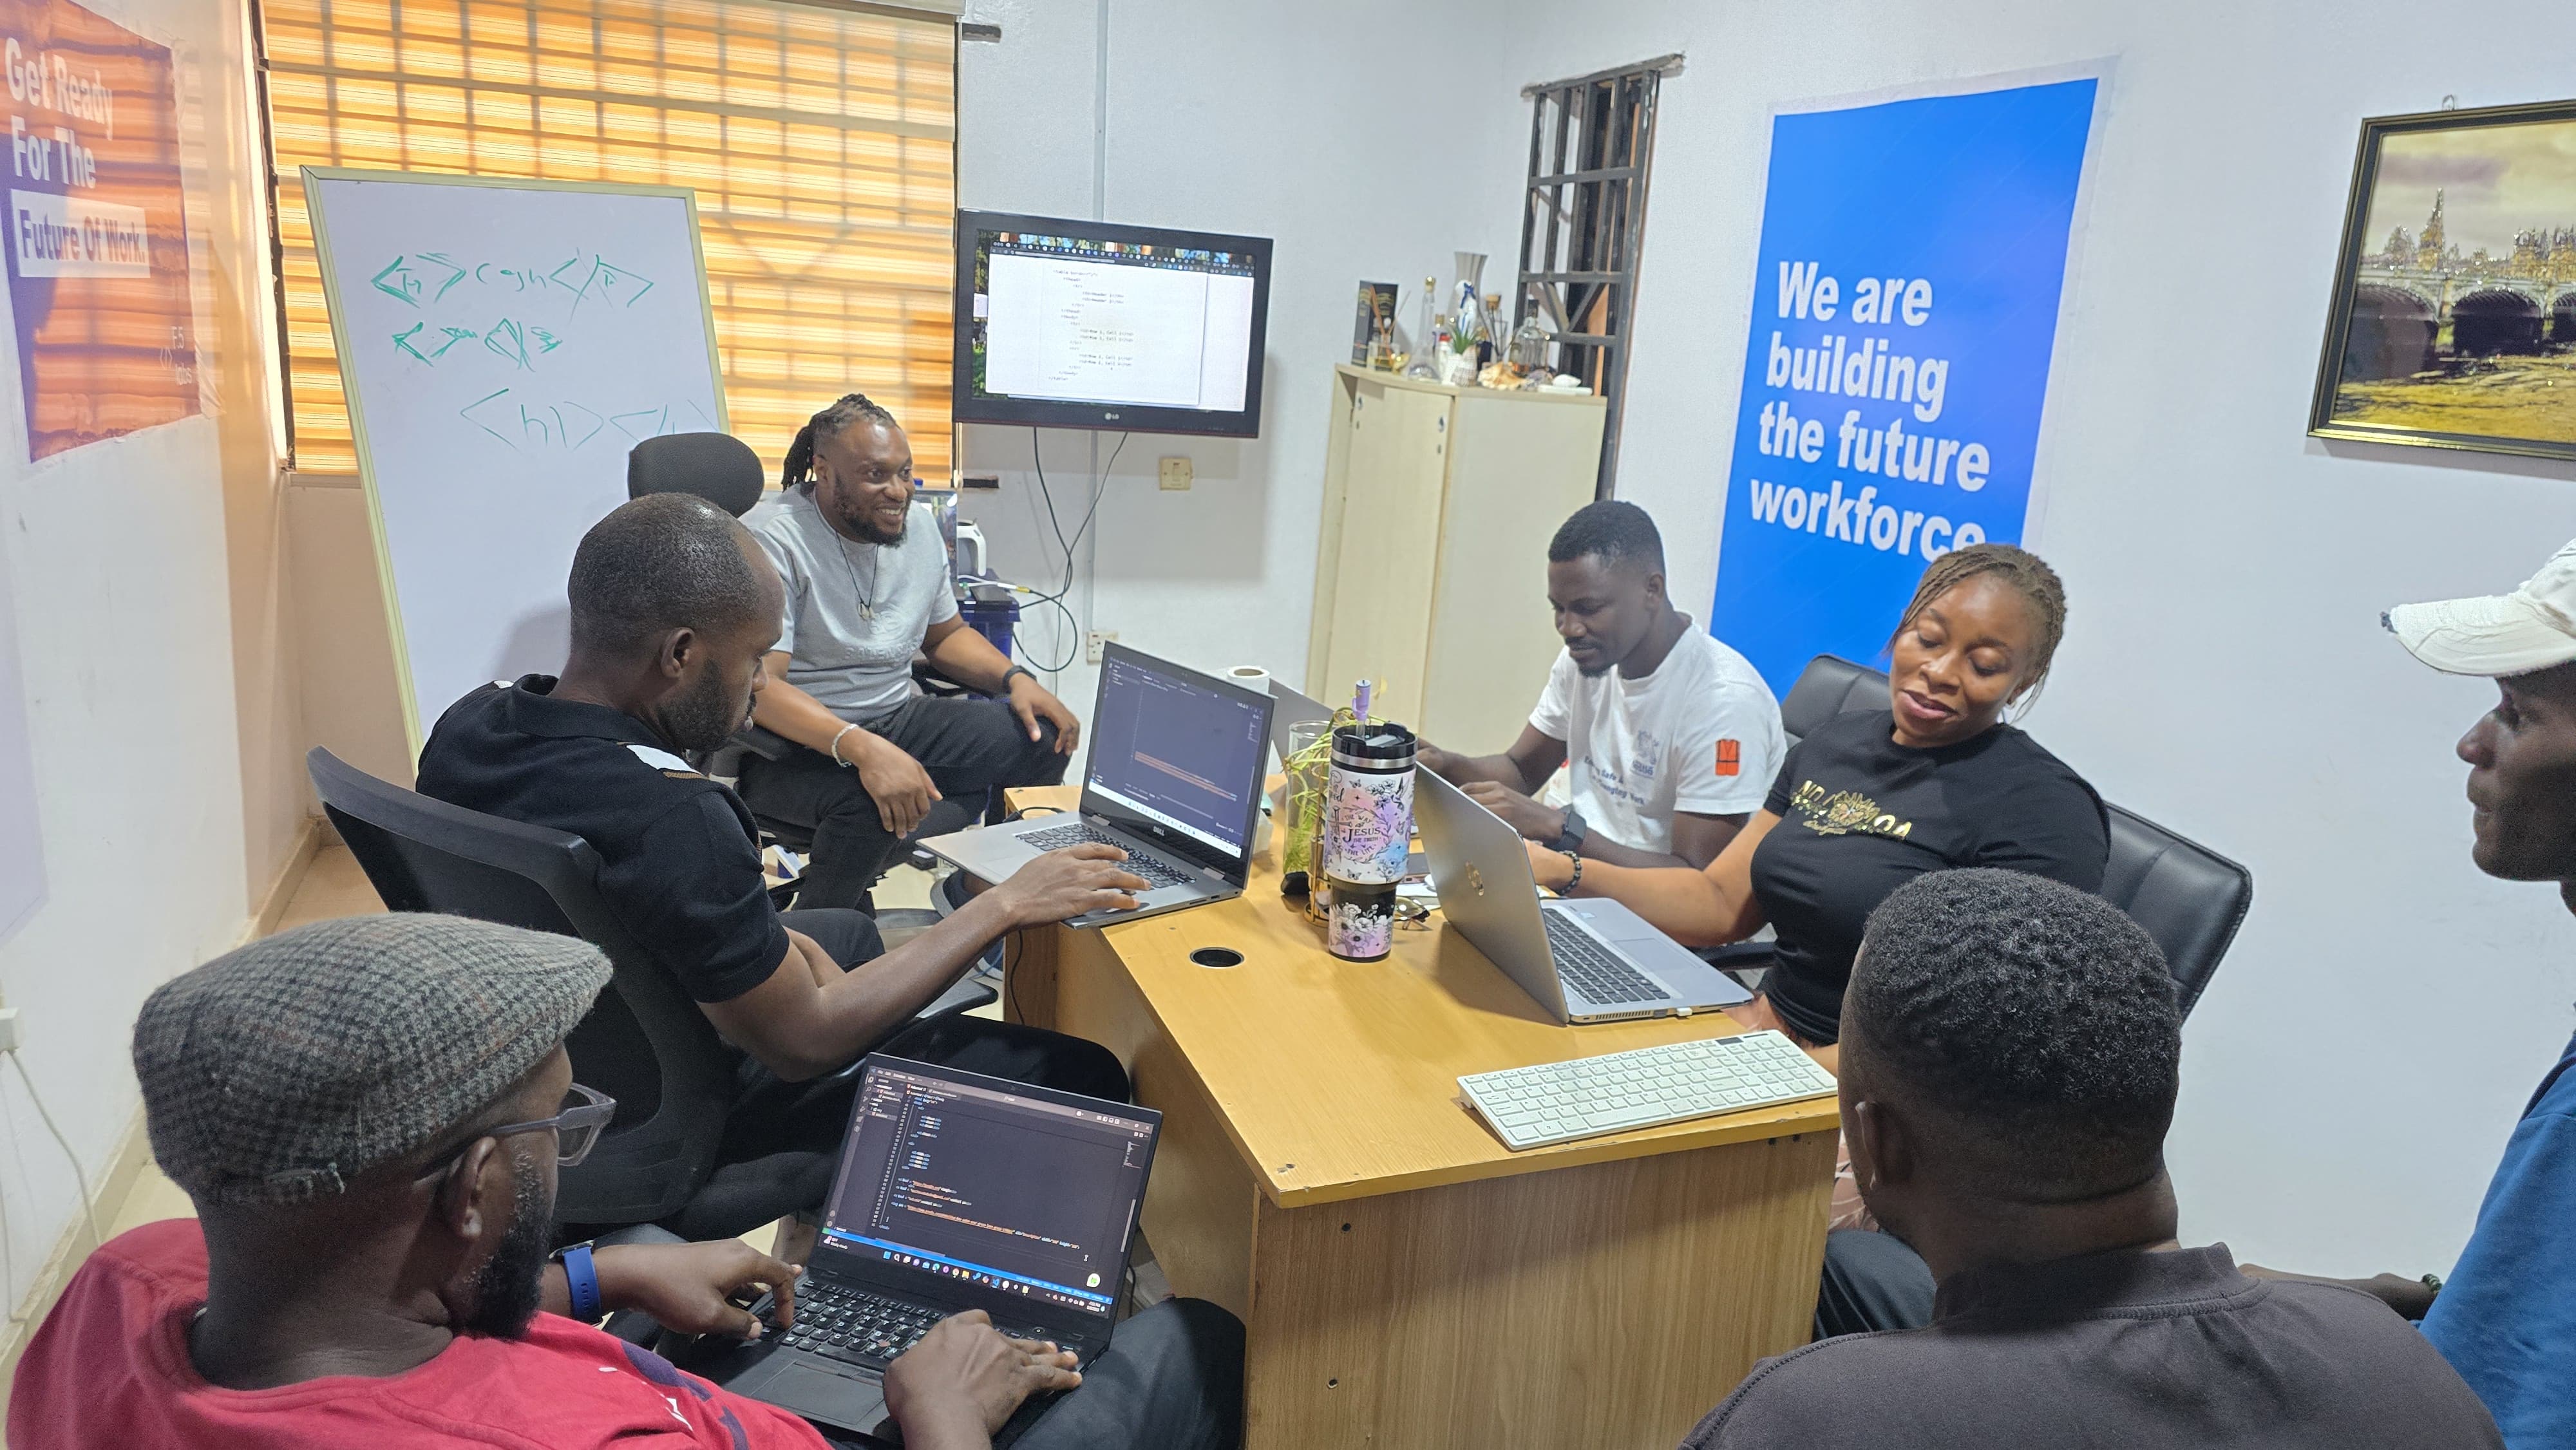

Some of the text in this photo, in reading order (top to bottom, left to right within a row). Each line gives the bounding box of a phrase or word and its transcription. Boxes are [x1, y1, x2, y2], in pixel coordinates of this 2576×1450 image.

[6, 37, 113, 141] Get Ready
[10, 115, 97, 189] For The
[19, 209, 146, 263] Future Of Work.
[1778, 261, 1933, 326] We are
[1766, 331, 1949, 423] building
[1759, 401, 1991, 492] the future
[1750, 479, 1986, 563] workforce
[1342, 827, 1381, 843] JESUS
